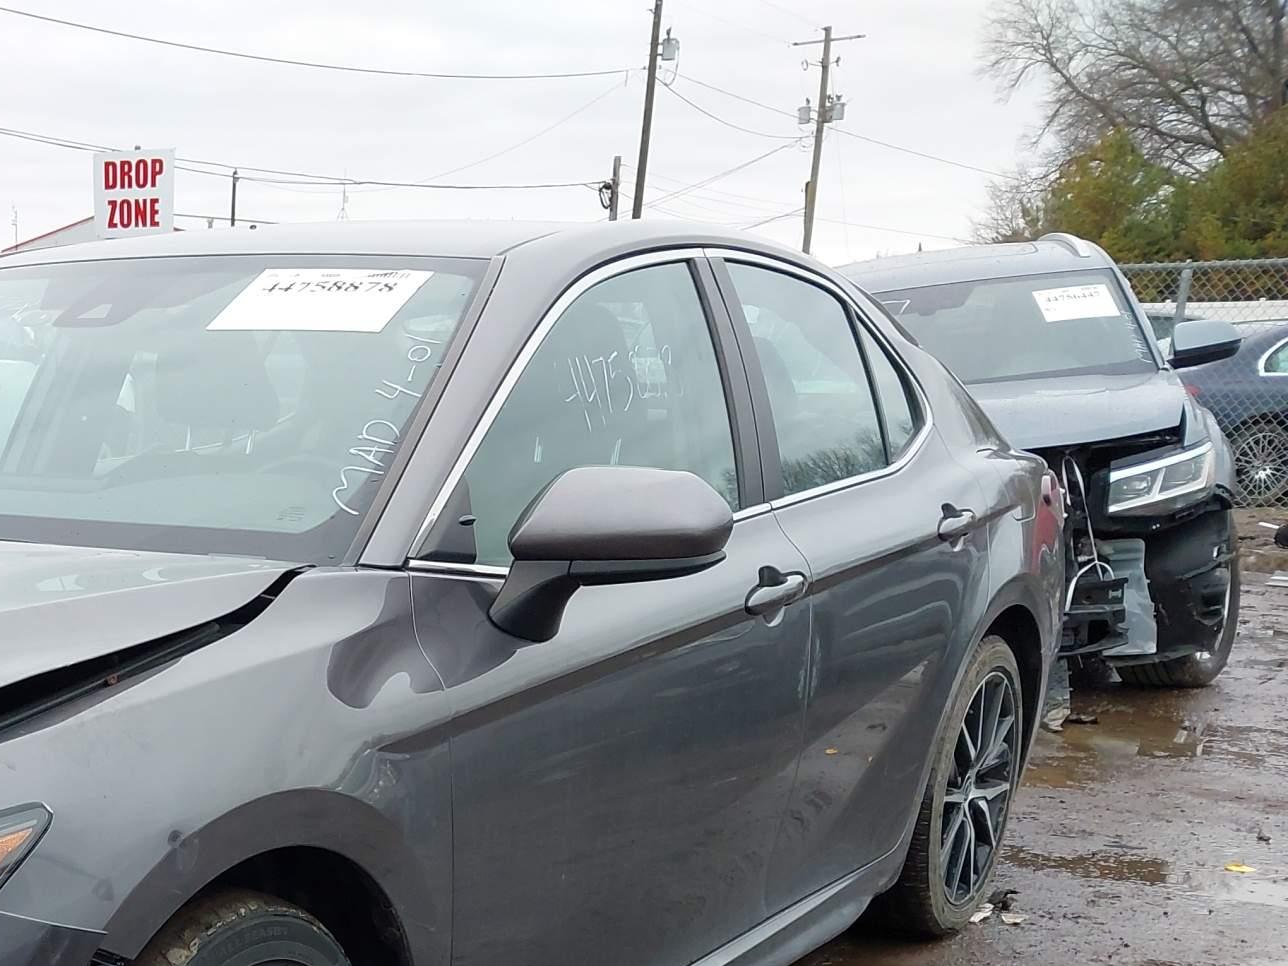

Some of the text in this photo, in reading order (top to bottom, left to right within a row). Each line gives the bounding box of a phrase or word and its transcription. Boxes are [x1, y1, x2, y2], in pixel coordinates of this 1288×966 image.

[104, 158, 164, 190] DROP
[107, 198, 160, 228] ZONE
[263, 281, 398, 293] 44758878
[332, 419, 401, 516] MAD
